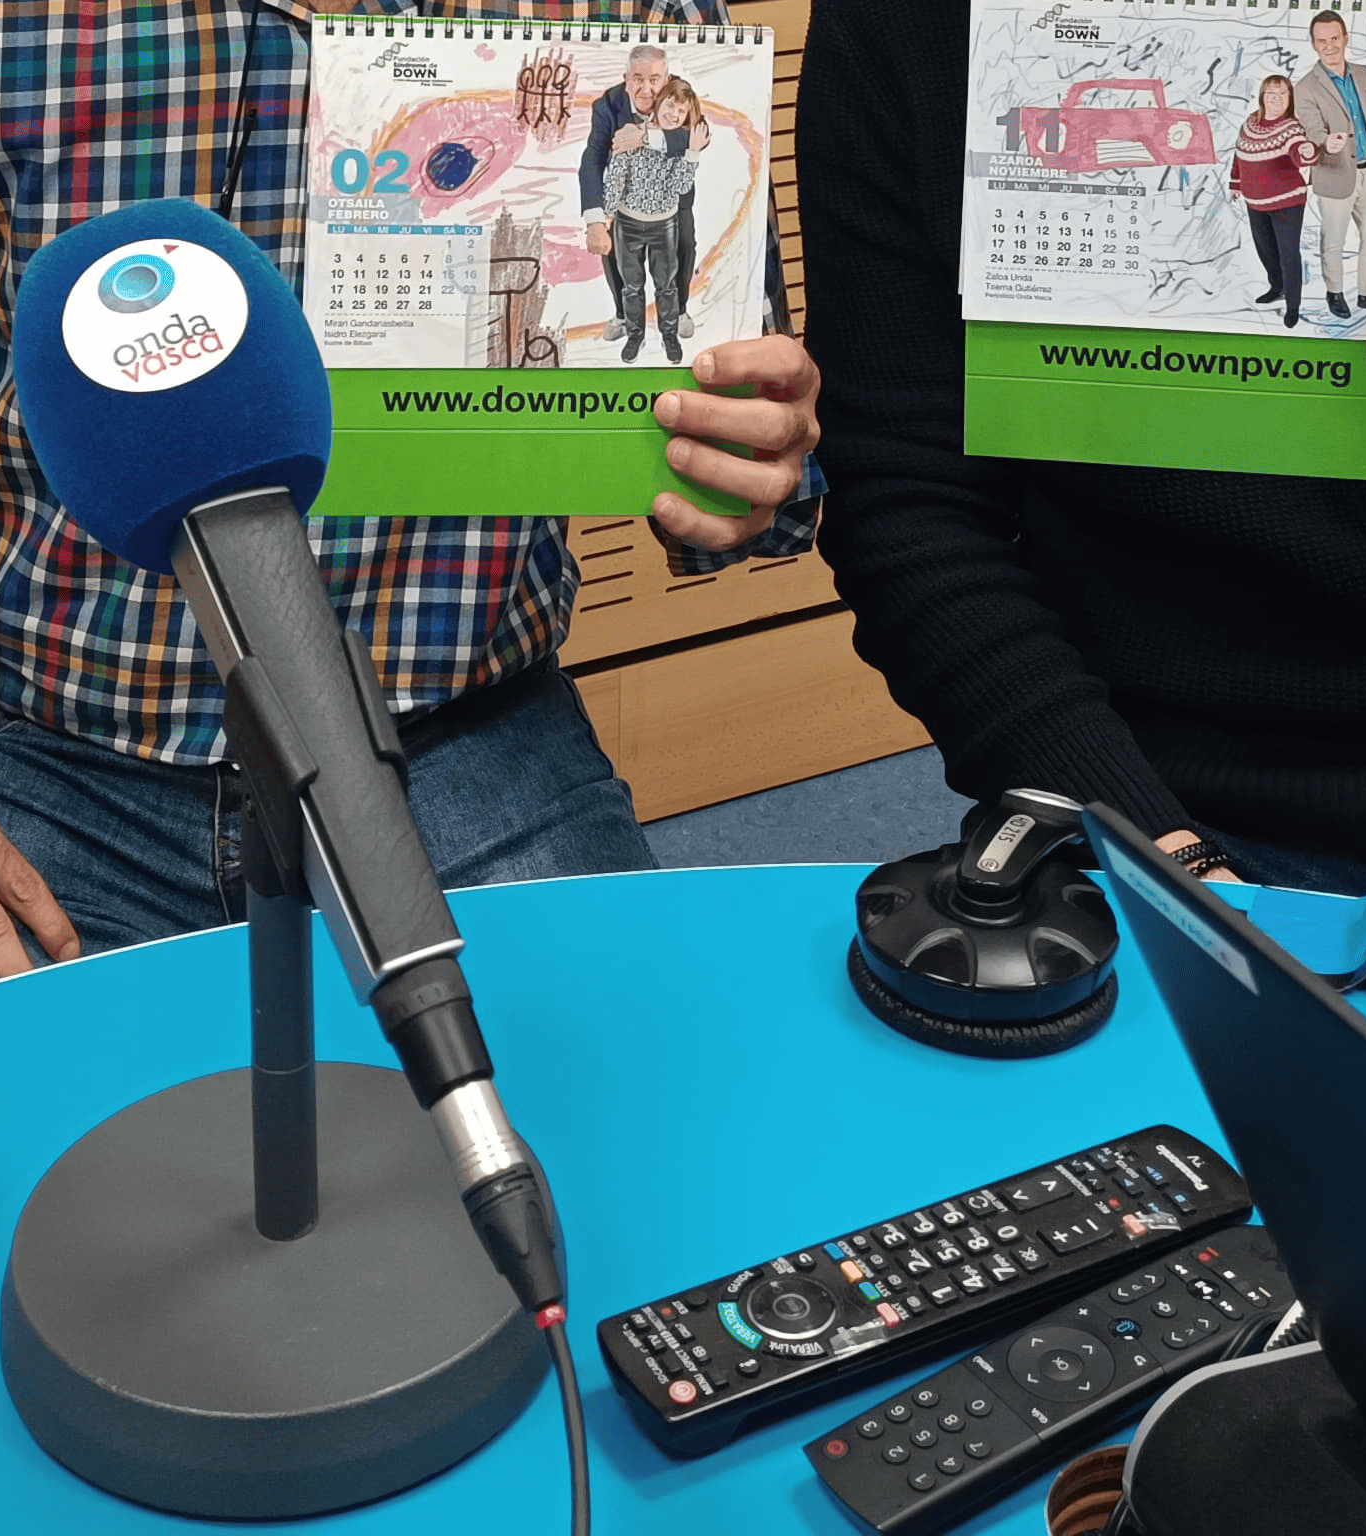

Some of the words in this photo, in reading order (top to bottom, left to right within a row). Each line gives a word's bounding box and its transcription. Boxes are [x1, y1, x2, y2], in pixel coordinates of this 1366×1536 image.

[1054, 29, 1100, 41] DOWN
[393, 67, 437, 79] DOWN
[995, 106, 1061, 153] 11
[988, 155, 1045, 166] AZAROA
[331, 148, 411, 194] 02
[988, 166, 1068, 179] NOVIEMBRE
[327, 198, 385, 209] OTSAILA
[1108, 199, 1114, 209] 1
[1130, 200, 1138, 210] 2
[327, 209, 390, 220] FEBRERO
[994, 208, 1003, 218] 3
[1016, 209, 1024, 219] 4
[1038, 210, 1047, 220] 5
[1061, 211, 1069, 222] 6
[1084, 212, 1091, 222] 7
[1106, 213, 1115, 224] 8
[1129, 215, 1138, 225] 9
[991, 223, 1005, 234] 10
[1014, 224, 1026, 234] 11
[1036, 225, 1050, 236] 12
[1058, 226, 1072, 237] 13
[1081, 228, 1094, 237] 14
[1104, 229, 1117, 239] 15
[1127, 230, 1140, 240] 16
[447, 239, 452, 249] 1
[467, 238, 475, 249] 2
[992, 238, 1005, 249] 17
[1013, 239, 1027, 250] 18
[1036, 240, 1049, 251] 19
[1057, 241, 1072, 252] 20
[1079, 242, 1092, 253] 21
[1102, 243, 1117, 254] 22
[1125, 245, 1140, 255] 23
[334, 253, 342, 264] 3
[356, 253, 364, 263] 4
[378, 253, 386, 264] 5
[400, 254, 408, 264] 6
[423, 254, 431, 264] 7
[990, 253, 1004, 264] 24
[1012, 254, 1027, 265] 25
[1034, 255, 1049, 266] 26
[1056, 256, 1071, 267] 27
[1078, 257, 1093, 268] 28
[1101, 258, 1116, 269] 29
[1124, 260, 1139, 270] 30
[331, 269, 345, 279] 10
[353, 269, 366, 279] 11
[375, 269, 389, 279] 12
[399, 269, 411, 280] 13
[420, 269, 433, 279] 14
[330, 284, 344, 295] 17
[352, 284, 367, 295] 18
[375, 284, 389, 295] 19
[396, 284, 411, 295] 20
[418, 284, 432, 295] 21
[329, 299, 344, 310] 24
[352, 299, 366, 310] 25
[374, 299, 388, 310] 26
[396, 300, 410, 310] 27
[418, 300, 432, 310] 28
[112, 313, 217, 368] onda
[121, 330, 225, 384] vasca
[1038, 343, 1353, 387] www.downpv.org
[381, 385, 664, 419] www.downpv.or
[997, 826, 1021, 844] 215
[997, 1225, 1018, 1239] 0
[932, 1286, 953, 1299] 1
